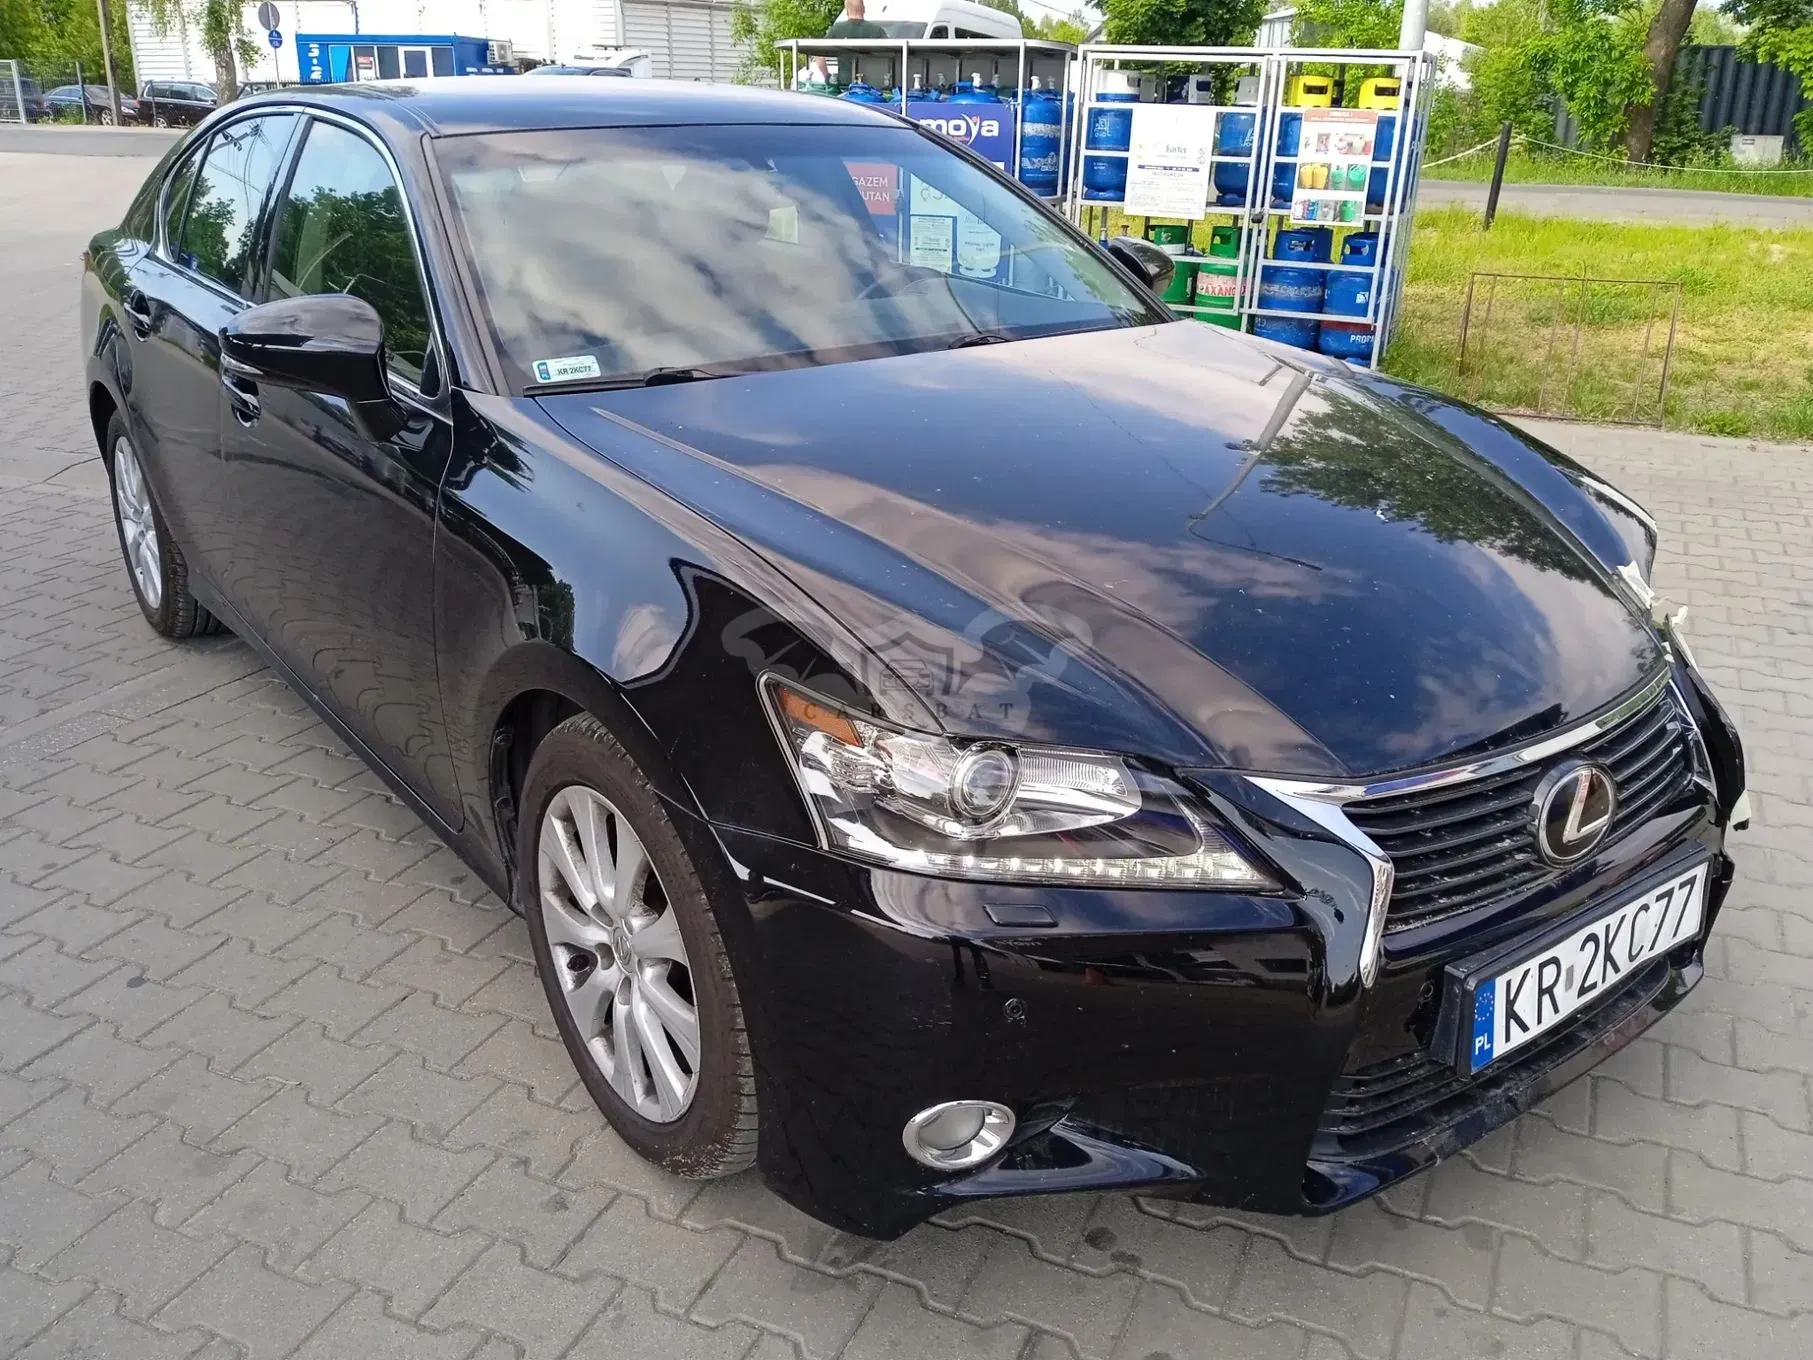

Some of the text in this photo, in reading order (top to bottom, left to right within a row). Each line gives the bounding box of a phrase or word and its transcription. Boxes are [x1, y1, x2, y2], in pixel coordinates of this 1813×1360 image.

[919, 113, 999, 145] moya
[859, 190, 890, 202] UTAN
[1504, 873, 1698, 1044] KR 2KC77
[1474, 1034, 1492, 1055] PL
